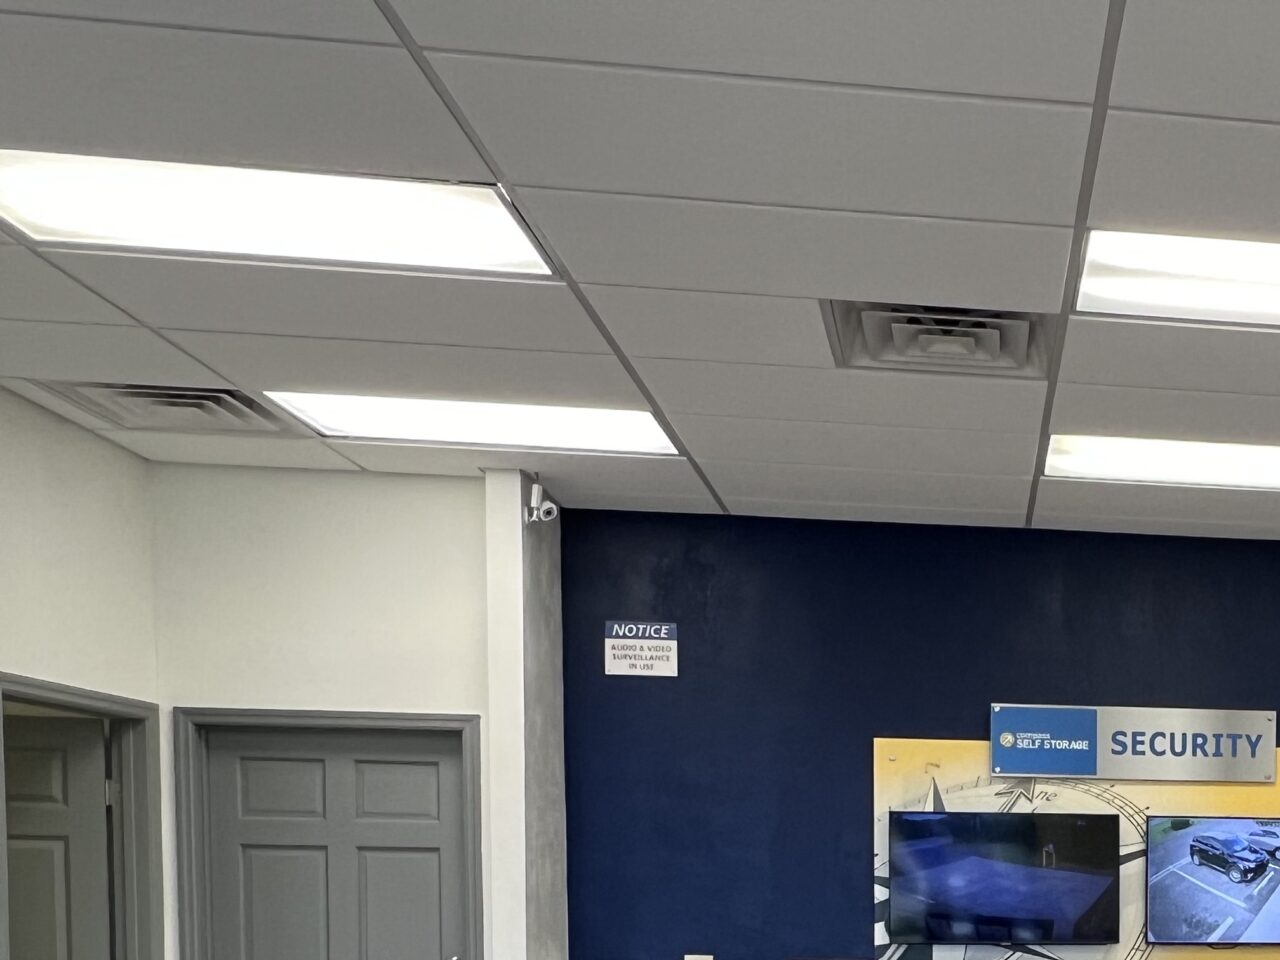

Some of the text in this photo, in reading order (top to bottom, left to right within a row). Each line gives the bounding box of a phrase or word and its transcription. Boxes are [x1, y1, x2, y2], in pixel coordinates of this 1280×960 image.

[612, 623, 670, 638] NOTICE
[611, 643, 672, 653] AUDIO & VIDEO
[612, 653, 670, 662] SURVEILLANCE
[639, 663, 654, 671] USE
[1016, 732, 1050, 740] compass
[1016, 739, 1089, 750] SELF STORAGE
[1110, 730, 1264, 759] SECURITY
